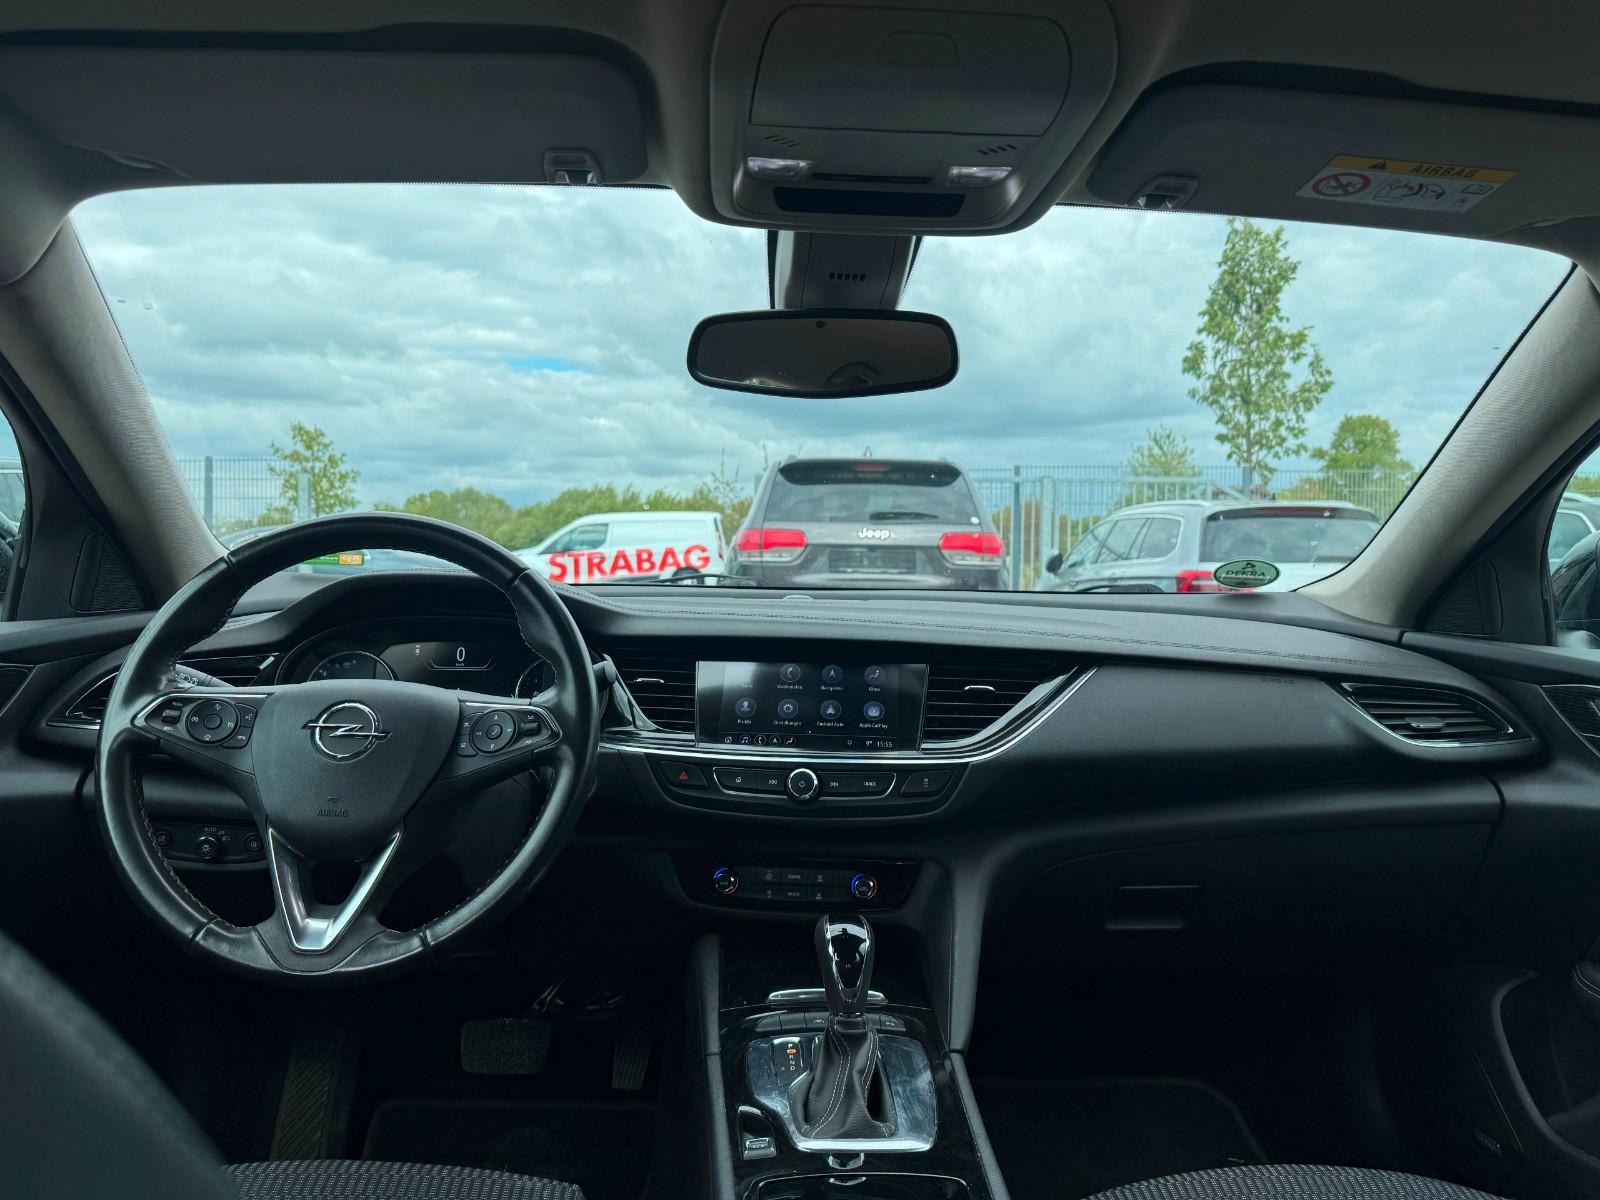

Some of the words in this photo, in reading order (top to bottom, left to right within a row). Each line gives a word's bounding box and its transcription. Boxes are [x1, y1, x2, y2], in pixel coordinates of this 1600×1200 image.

[1409, 164, 1479, 179] AIRBAG
[858, 528, 890, 540] Jeep
[548, 544, 711, 584] STRABAG
[1225, 569, 1266, 577] DEKRA
[456, 646, 466, 662] 0
